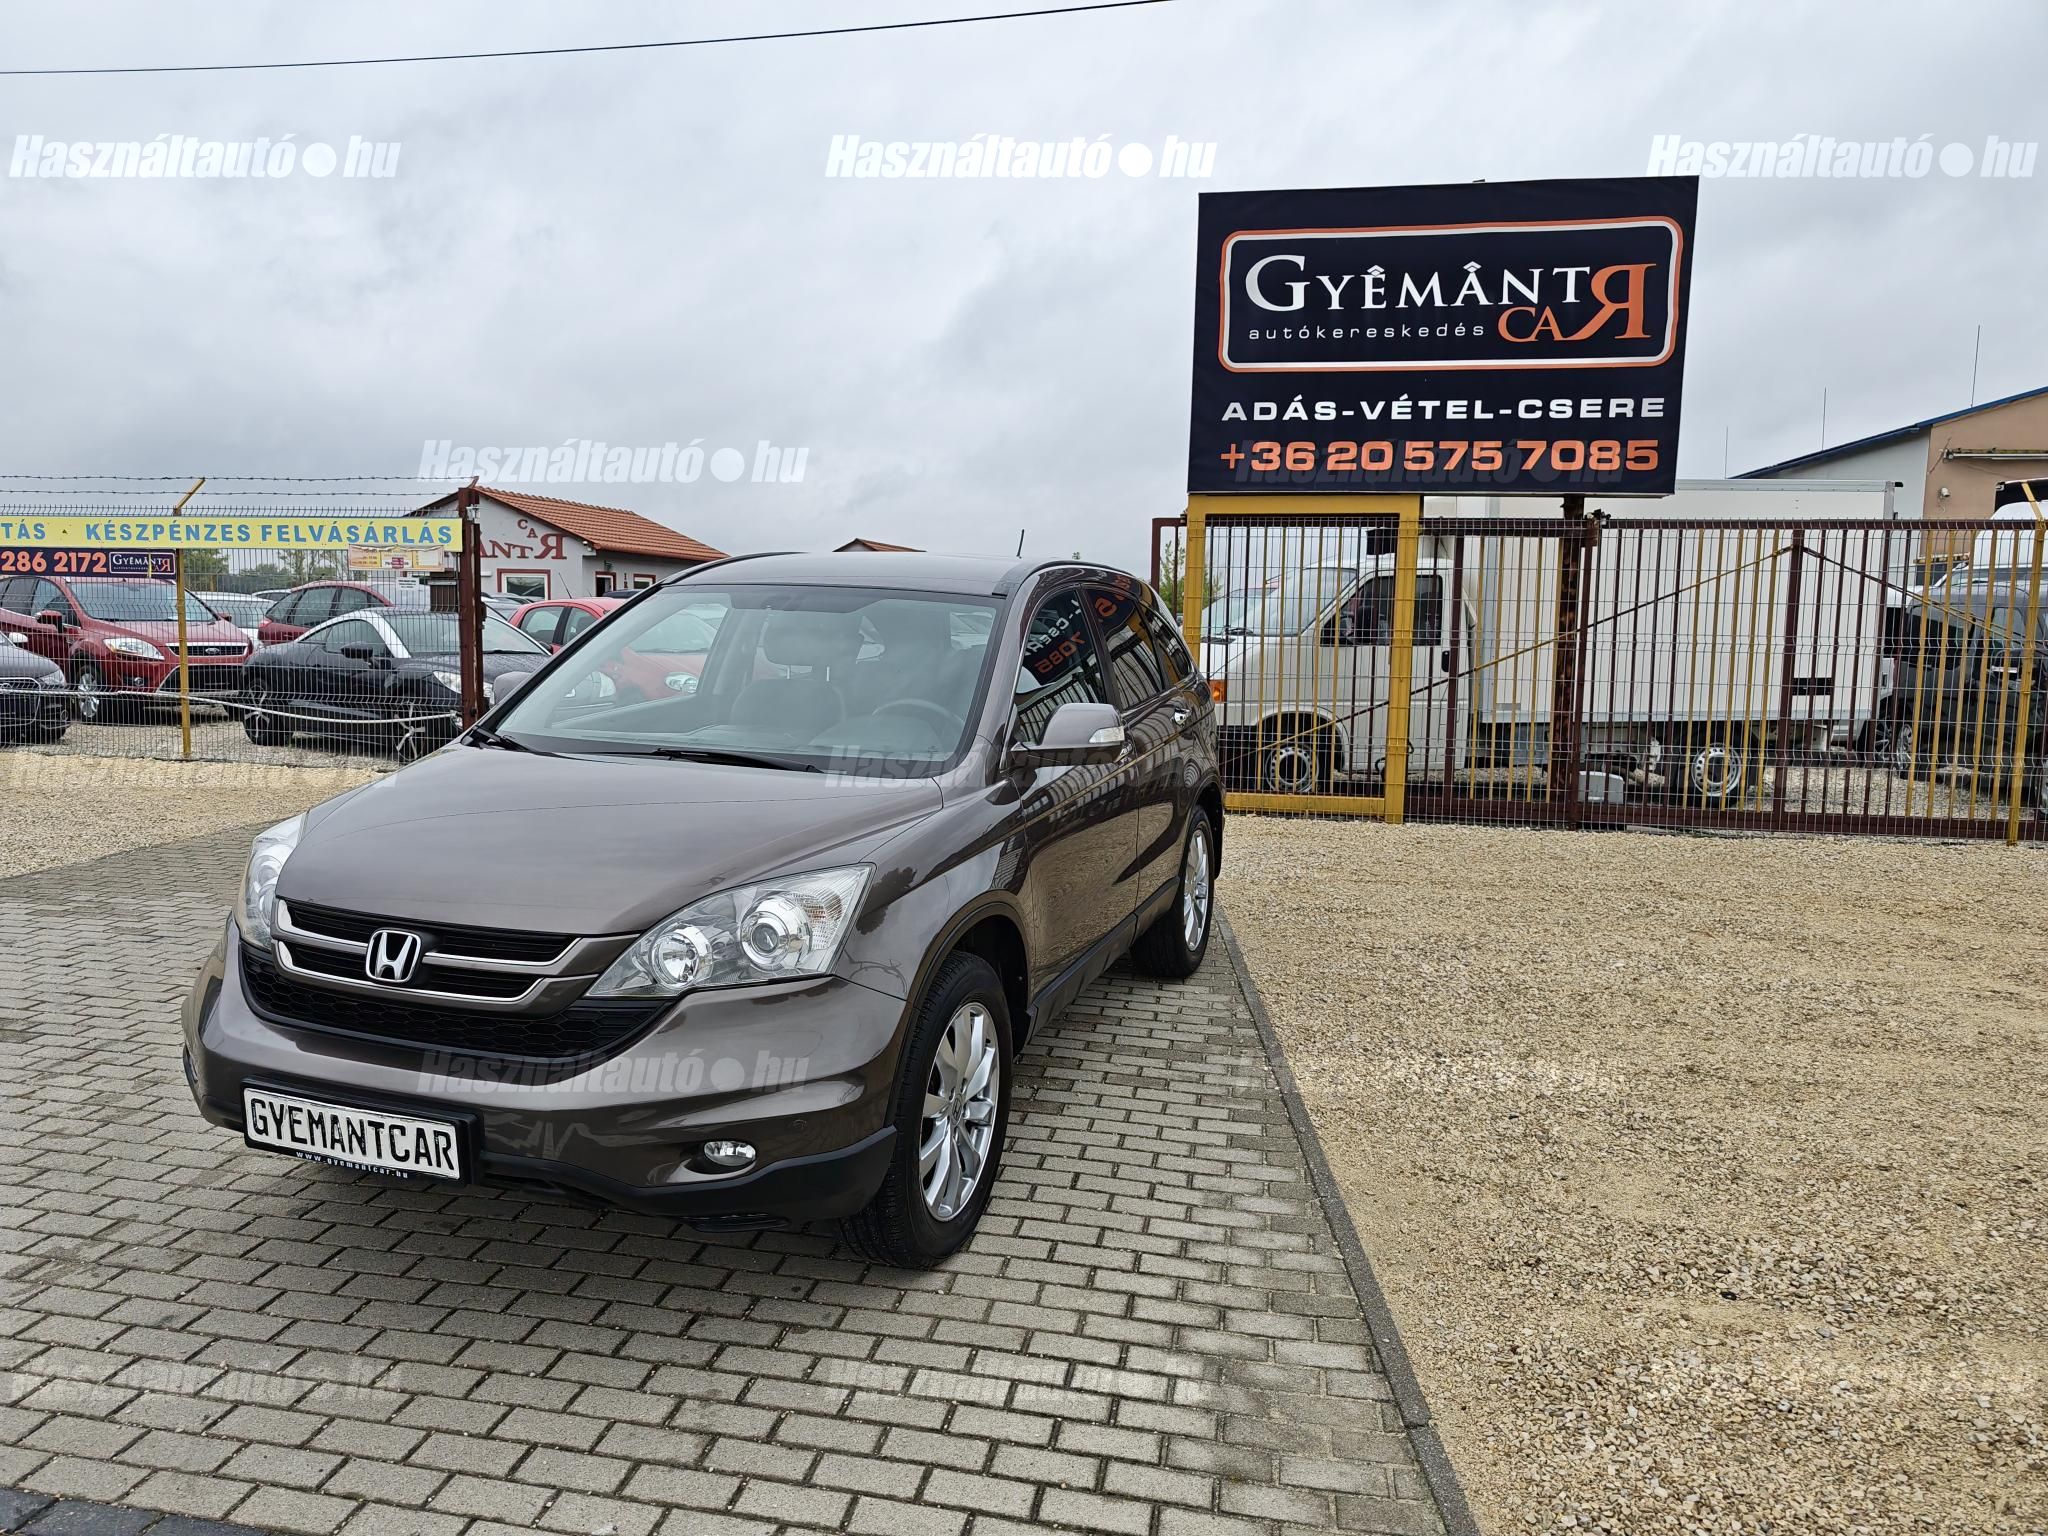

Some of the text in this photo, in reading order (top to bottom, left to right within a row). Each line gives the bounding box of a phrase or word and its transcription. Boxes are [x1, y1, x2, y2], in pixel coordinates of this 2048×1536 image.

[1248, 322, 1485, 340] autókereskedés
[1221, 394, 1665, 421] ADÁS-VÉTEL-CSERE
[1220, 439, 1659, 471] +36 20 575 7085
[85, 520, 251, 543] KÉSZPÉNZES
[261, 521, 452, 544] FELVÁSÁRLÁS
[1, 551, 108, 574] 286 2172
[250, 1097, 455, 1171] GYEMANTCAR
